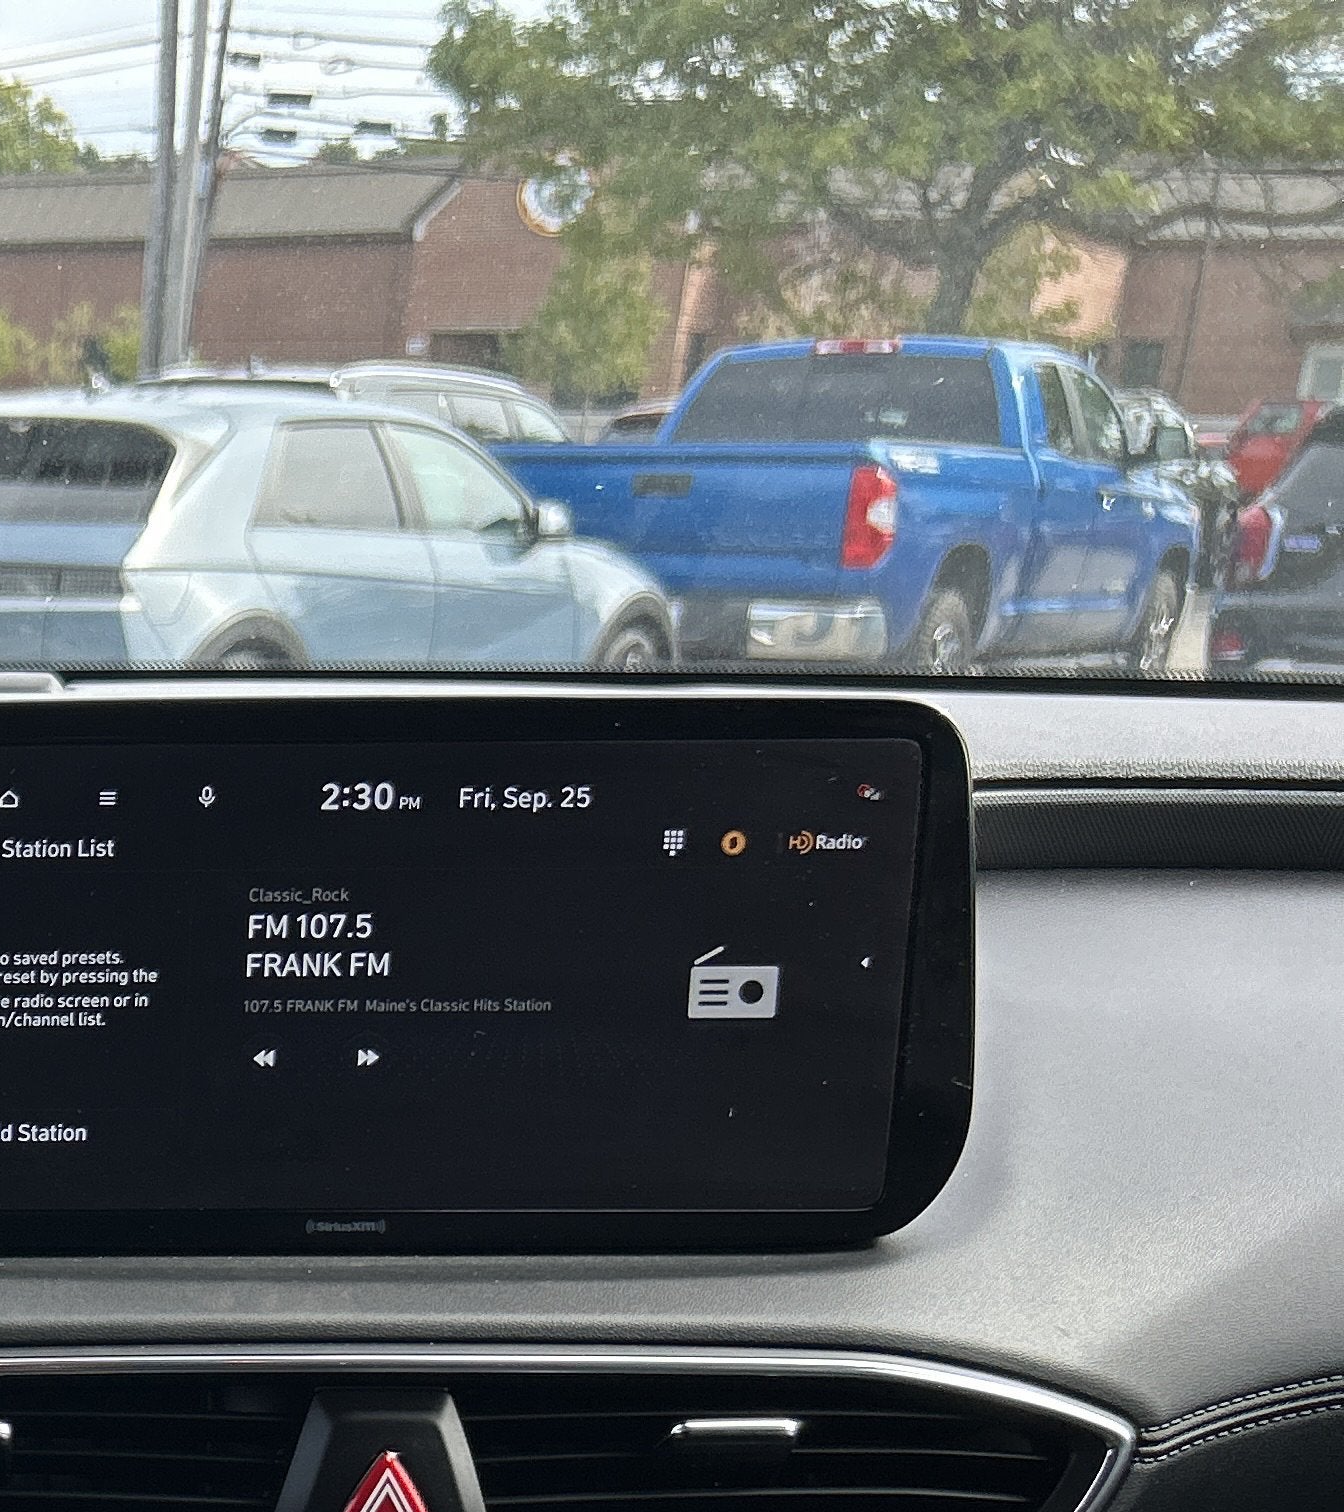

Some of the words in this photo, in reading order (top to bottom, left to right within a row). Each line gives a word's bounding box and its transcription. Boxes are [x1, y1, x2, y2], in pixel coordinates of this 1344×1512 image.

[320, 782, 394, 811] 2:30
[399, 797, 422, 810] PM
[458, 786, 496, 811] Fri,
[503, 787, 553, 813] Sep.
[560, 786, 592, 808] 25
[1, 838, 72, 859] Station
[77, 838, 115, 859] List
[816, 834, 863, 850] Radio
[248, 887, 349, 904] Classic_Rock
[248, 914, 288, 939] FM
[296, 913, 373, 939] 107.5
[13, 951, 58, 966] saved
[61, 951, 124, 968] presets.
[246, 953, 342, 978] FRANK
[350, 952, 390, 977] FM
[40, 969, 58, 986] by
[62, 969, 128, 987] pressing
[132, 969, 158, 983] the
[14, 994, 54, 1008] radio
[57, 996, 110, 1008] screen
[113, 996, 131, 1007] or
[134, 994, 148, 1007] in
[243, 999, 282, 1013] 107.5
[286, 1000, 334, 1013] FRANK
[338, 1000, 358, 1012] FM
[365, 1000, 417, 1013] Maine's
[420, 999, 470, 1012] Classic
[473, 999, 500, 1012] Hits
[504, 999, 552, 1012] Station
[78, 1012, 106, 1027] list.
[17, 1123, 88, 1142] Station
